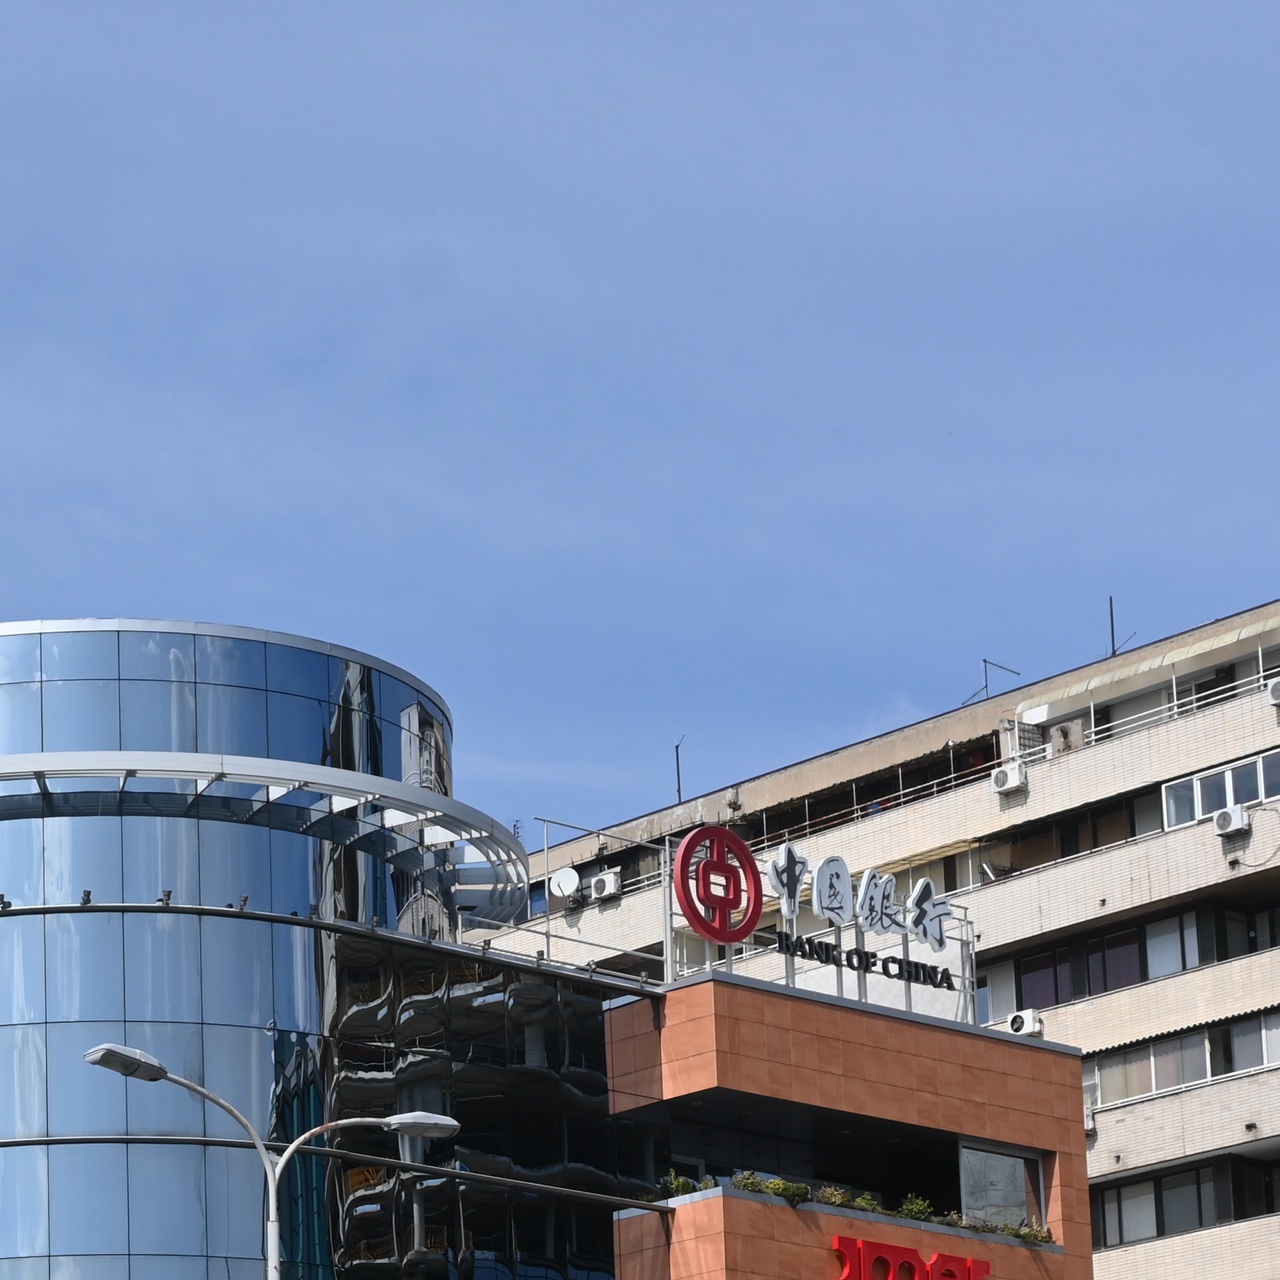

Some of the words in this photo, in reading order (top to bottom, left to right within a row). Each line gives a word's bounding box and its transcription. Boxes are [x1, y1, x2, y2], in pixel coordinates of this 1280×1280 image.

[778, 931, 843, 968] BANK
[846, 948, 878, 974] OF
[881, 955, 957, 992] CHINA
